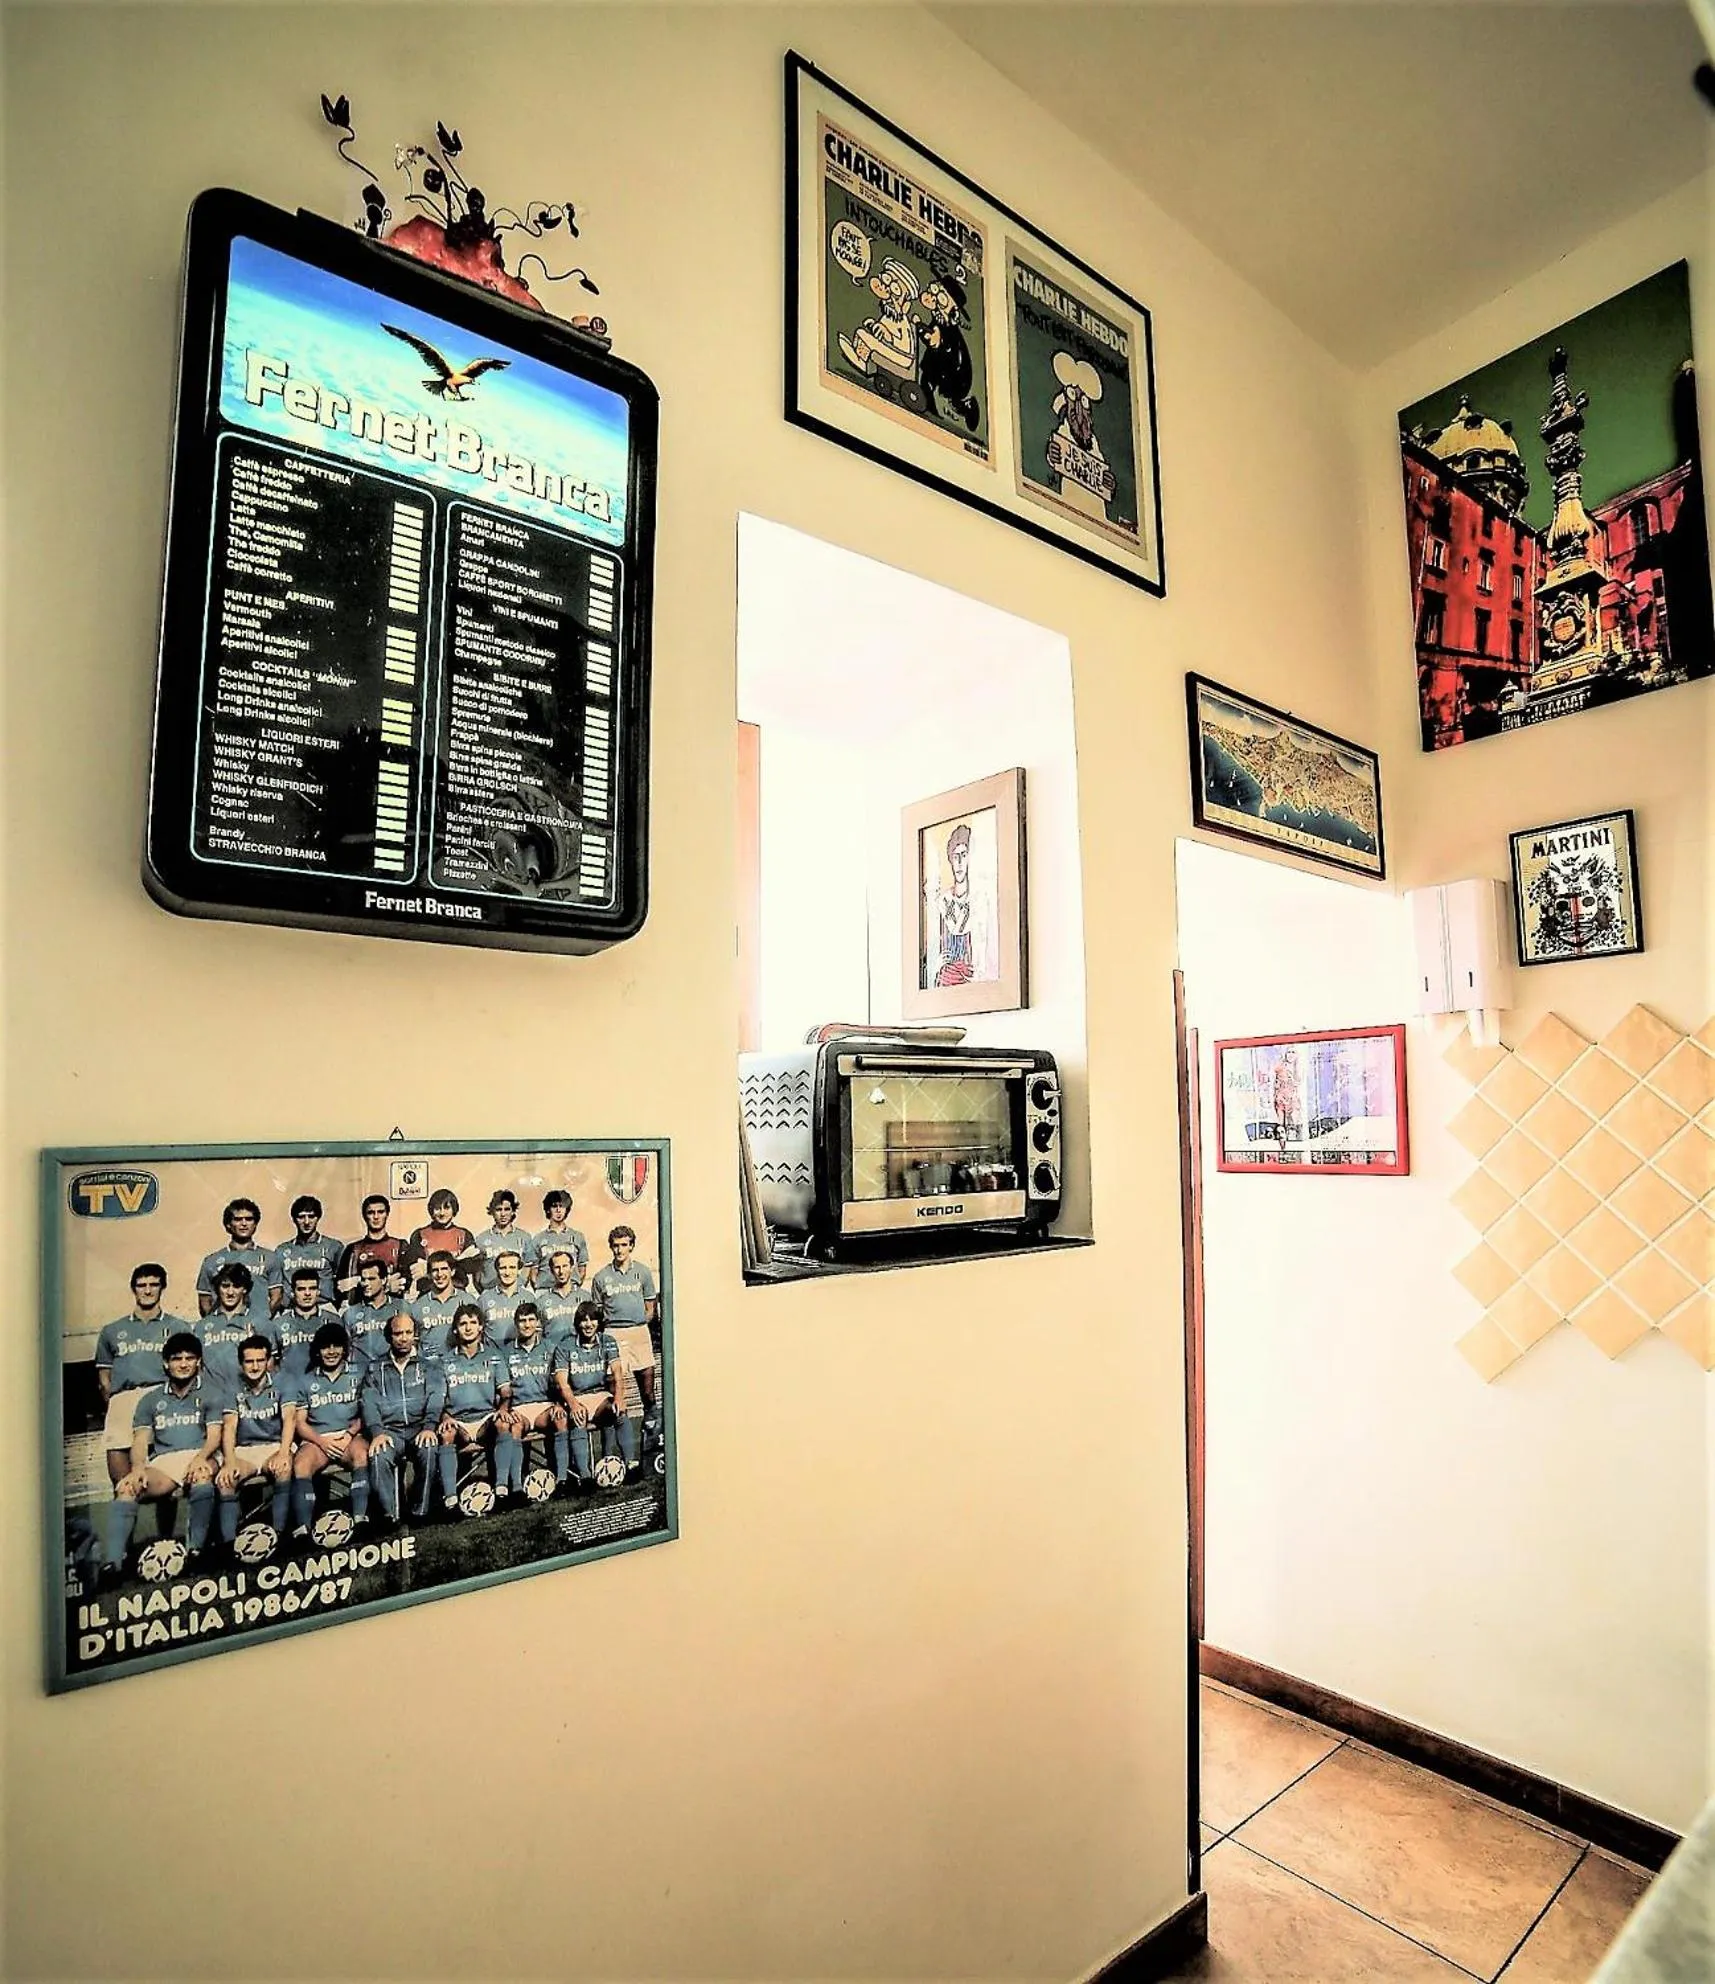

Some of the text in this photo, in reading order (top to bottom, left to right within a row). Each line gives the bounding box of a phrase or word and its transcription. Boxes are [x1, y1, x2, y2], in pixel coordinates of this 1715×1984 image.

[825, 133, 912, 211] CHARLIE
[846, 197, 949, 272] INTOUCHABLES
[956, 264, 967, 285] 2
[1014, 265, 1129, 358] CHARLIE HEBDO
[245, 349, 611, 523] Fernet Branca
[1066, 444, 1080, 462] JE
[261, 475, 292, 490] freddo
[262, 465, 305, 483] espresso
[285, 459, 351, 485] CAFFETTERIA
[231, 490, 289, 512] Cappuccino
[260, 486, 318, 509] decaffeinato
[231, 501, 256, 516] Latte
[230, 513, 306, 539] Latte macchiato
[461, 512, 529, 540] FERNET BRANCA
[461, 522, 524, 548] BRANCAMENTA
[250, 541, 281, 556] freddo
[460, 532, 484, 546] Amari
[227, 548, 278, 568] Cioccolata
[460, 548, 495, 566] GRAPPA
[460, 560, 488, 574] Grappa
[255, 567, 293, 582] corretto
[224, 589, 253, 603] PUNT
[459, 579, 486, 594] Liquori
[488, 577, 516, 592] SPORT
[517, 585, 562, 605] BORGHETTI
[223, 601, 272, 620] Vermouth
[286, 591, 334, 610] APERITIVI
[222, 613, 261, 628] Marsala
[492, 604, 509, 616] VINI
[517, 611, 558, 629] SPUMANTI
[221, 637, 298, 659] Aperitivi alcolici
[222, 625, 309, 650] Aperitivi analcolici
[455, 627, 556, 659] Spumanti metodo classico
[455, 637, 502, 655] SPUMANTE
[455, 648, 502, 666] Champagne
[219, 666, 311, 691] Cocktails analcolici
[252, 661, 310, 679] COCKTAILS
[493, 672, 520, 686] BIBITE
[219, 679, 296, 700] Cocktails alcolici
[452, 686, 512, 705] Succhi di frutta
[453, 674, 522, 697] Bibite analcoliche
[218, 690, 322, 717] Long Drinks analcolici
[452, 696, 528, 720] Succo di pomodoro
[217, 702, 310, 727] Long Drinks alcolici
[451, 718, 477, 730] Acqua
[479, 724, 512, 737] minerale
[215, 733, 294, 754] WHISKY MATCH
[262, 728, 340, 750] LIQUORI ESTERI
[214, 745, 303, 767] WHISKY GRANT'S
[450, 739, 522, 761] Birra spina piccola
[213, 757, 249, 772] Whisky
[450, 751, 521, 772] Birra spina grande
[213, 769, 323, 794] WHISKY GLENFIDDICH
[449, 762, 469, 772] Birra
[471, 767, 478, 775] in
[520, 774, 543, 787] lattina
[449, 773, 517, 792] BIRRA GROLSCH
[211, 795, 249, 808] Cognac
[212, 782, 283, 801] Whisky riserva
[448, 784, 494, 799] Birra estera
[210, 807, 274, 823] Liquori esteri
[447, 812, 483, 825] Brioches
[460, 802, 516, 820] PASTICCERIA
[524, 813, 583, 830] GASTRONOMIA
[209, 825, 245, 840] Brandy
[446, 823, 472, 834] Panini
[209, 838, 326, 861] STRAVECCHIO BRANCA
[445, 834, 496, 849] Panini farciti
[445, 846, 469, 856] Toast
[1531, 827, 1611, 859] MARTINI
[443, 868, 477, 881] Pizzette
[444, 857, 489, 871] Tramezzini
[365, 890, 482, 920] Fernet Branca
[79, 1184, 149, 1214] TV
[916, 1204, 964, 1217] KENDO
[78, 1604, 109, 1631] IL
[118, 1571, 246, 1622] NAPOLI
[257, 1535, 417, 1590] CAMPIONE
[79, 1576, 353, 1662] D'ITALIA 1986/87
